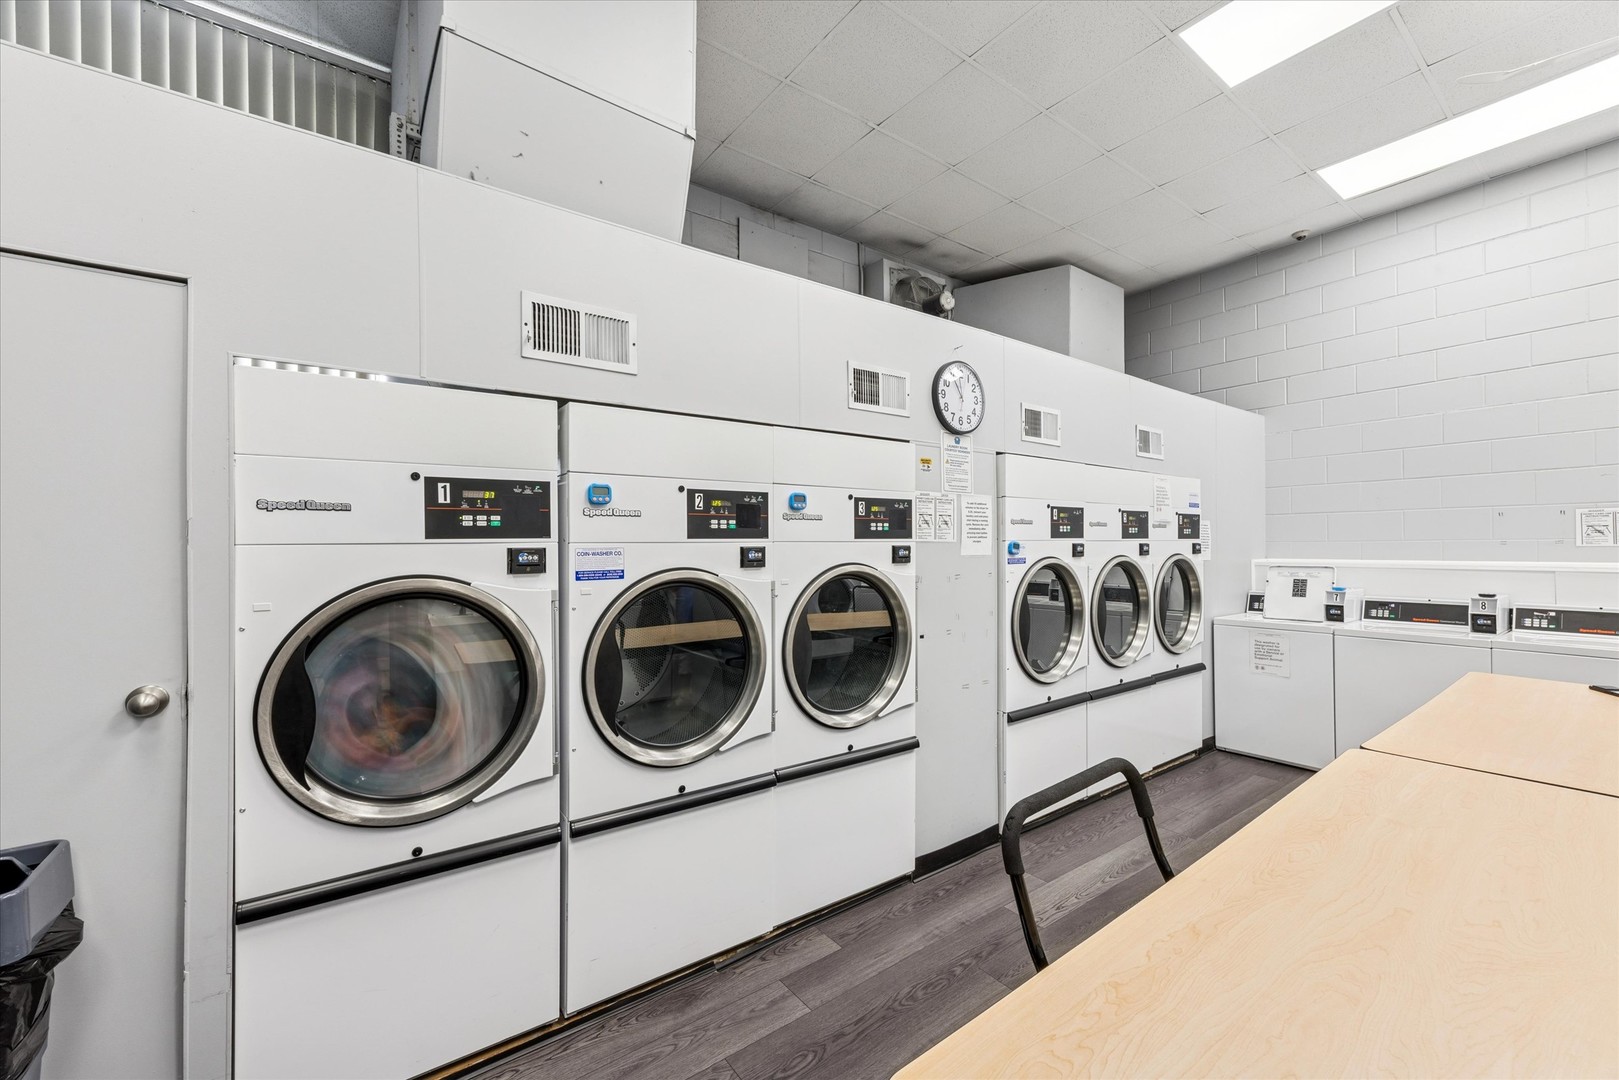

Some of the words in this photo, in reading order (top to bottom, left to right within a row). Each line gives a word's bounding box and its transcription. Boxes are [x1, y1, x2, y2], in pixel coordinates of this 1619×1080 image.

[972, 384, 976, 393] 2
[941, 389, 946, 399] 9
[974, 396, 978, 405] 3
[944, 402, 949, 412] 8
[972, 408, 976, 416] 4
[951, 412, 955, 422] 7
[958, 416, 964, 426] 6
[967, 415, 972, 424] 5
[441, 484, 448, 502] 1
[697, 495, 702, 509] 2
[860, 502, 864, 514] 3
[1481, 602, 1486, 610] 8
